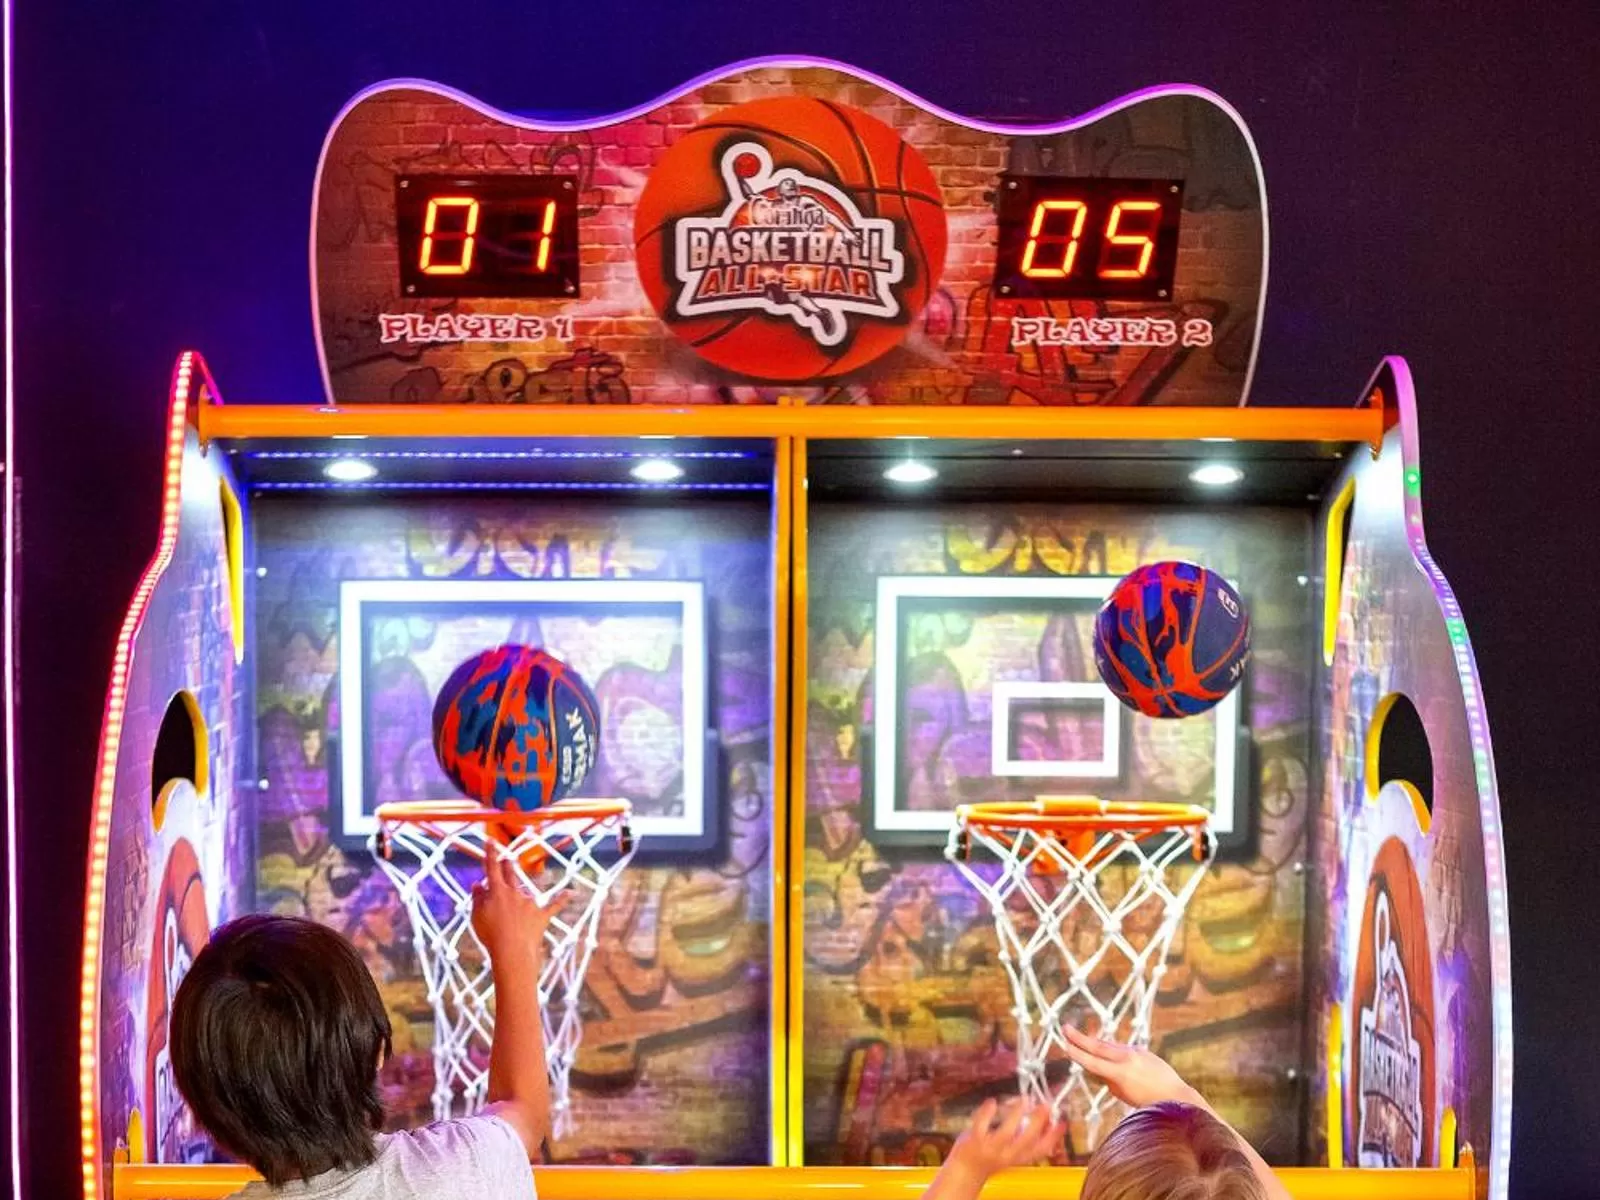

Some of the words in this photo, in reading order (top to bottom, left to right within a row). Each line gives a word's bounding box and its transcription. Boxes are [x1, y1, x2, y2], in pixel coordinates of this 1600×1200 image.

[419, 196, 557, 276] 01
[688, 228, 892, 270] BASKETBALL
[1021, 200, 1162, 280] 05
[698, 264, 766, 297] ALL
[782, 264, 877, 298] STAR
[379, 314, 546, 342] PLAYER
[553, 315, 574, 341] 1
[1011, 318, 1177, 346] PLAYER
[1182, 319, 1213, 347] 2
